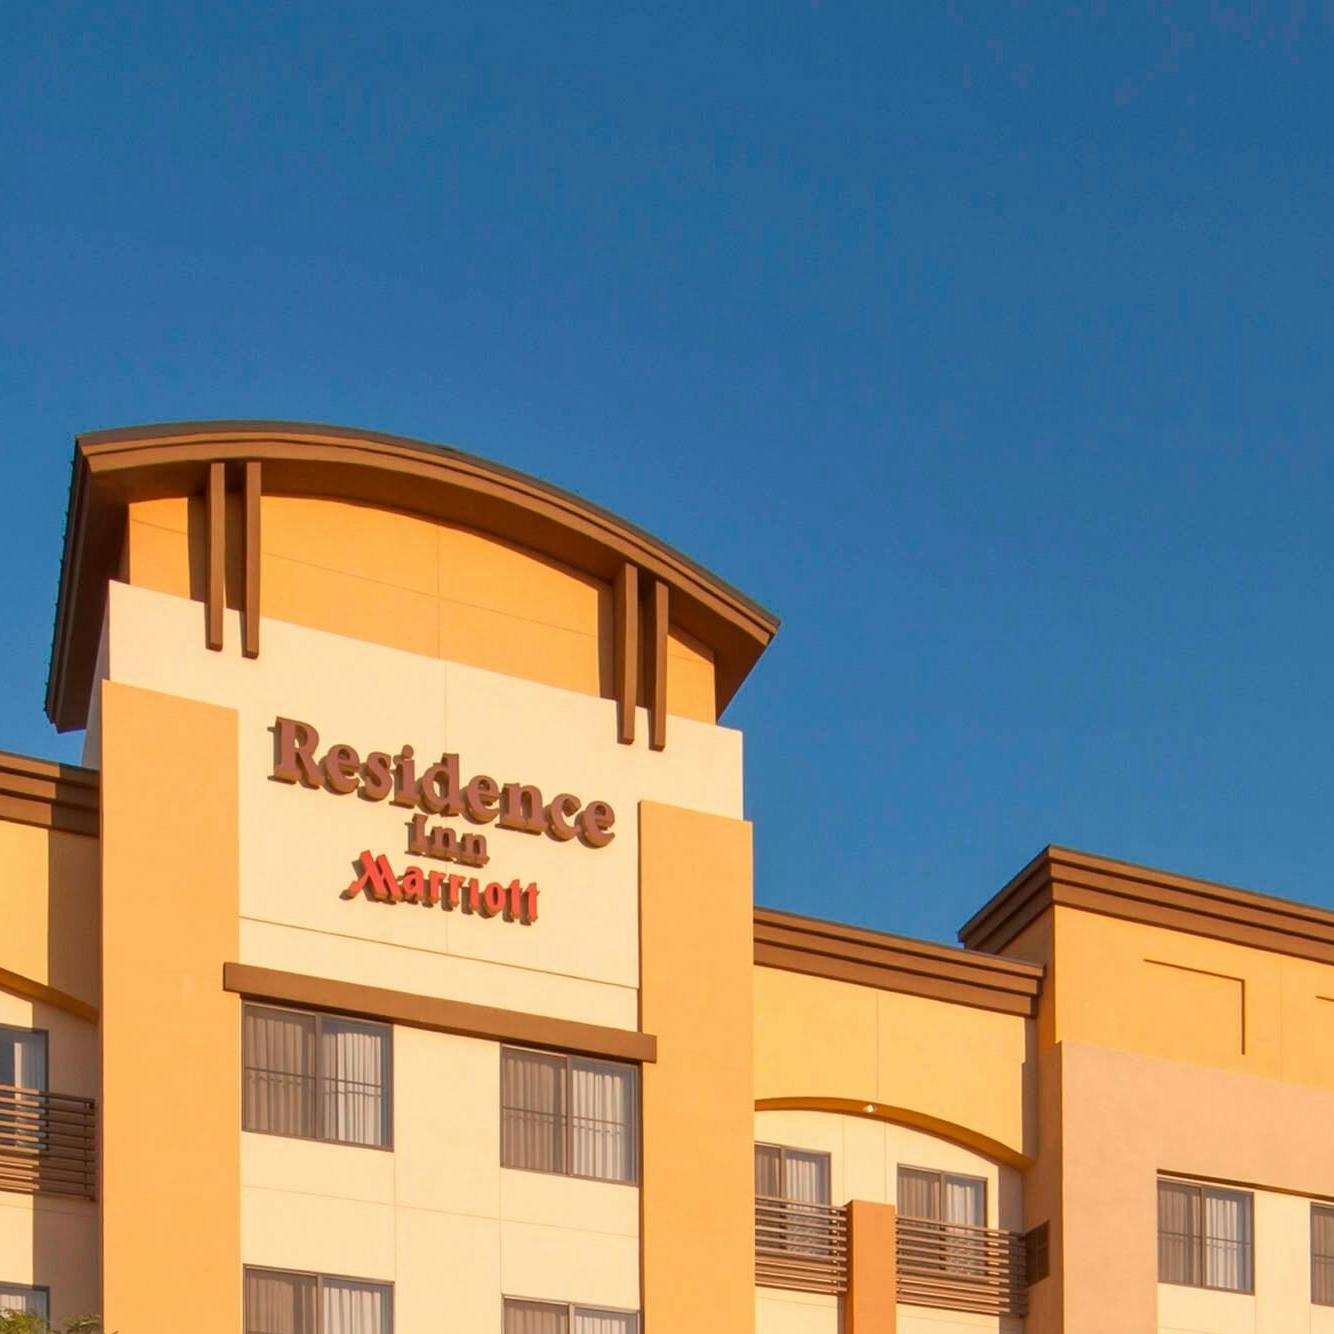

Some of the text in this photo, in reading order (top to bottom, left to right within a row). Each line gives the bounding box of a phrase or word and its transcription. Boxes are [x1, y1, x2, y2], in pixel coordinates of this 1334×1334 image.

[270, 716, 616, 848] Residence
[405, 813, 490, 867] Inn
[340, 850, 540, 924] Marriott
